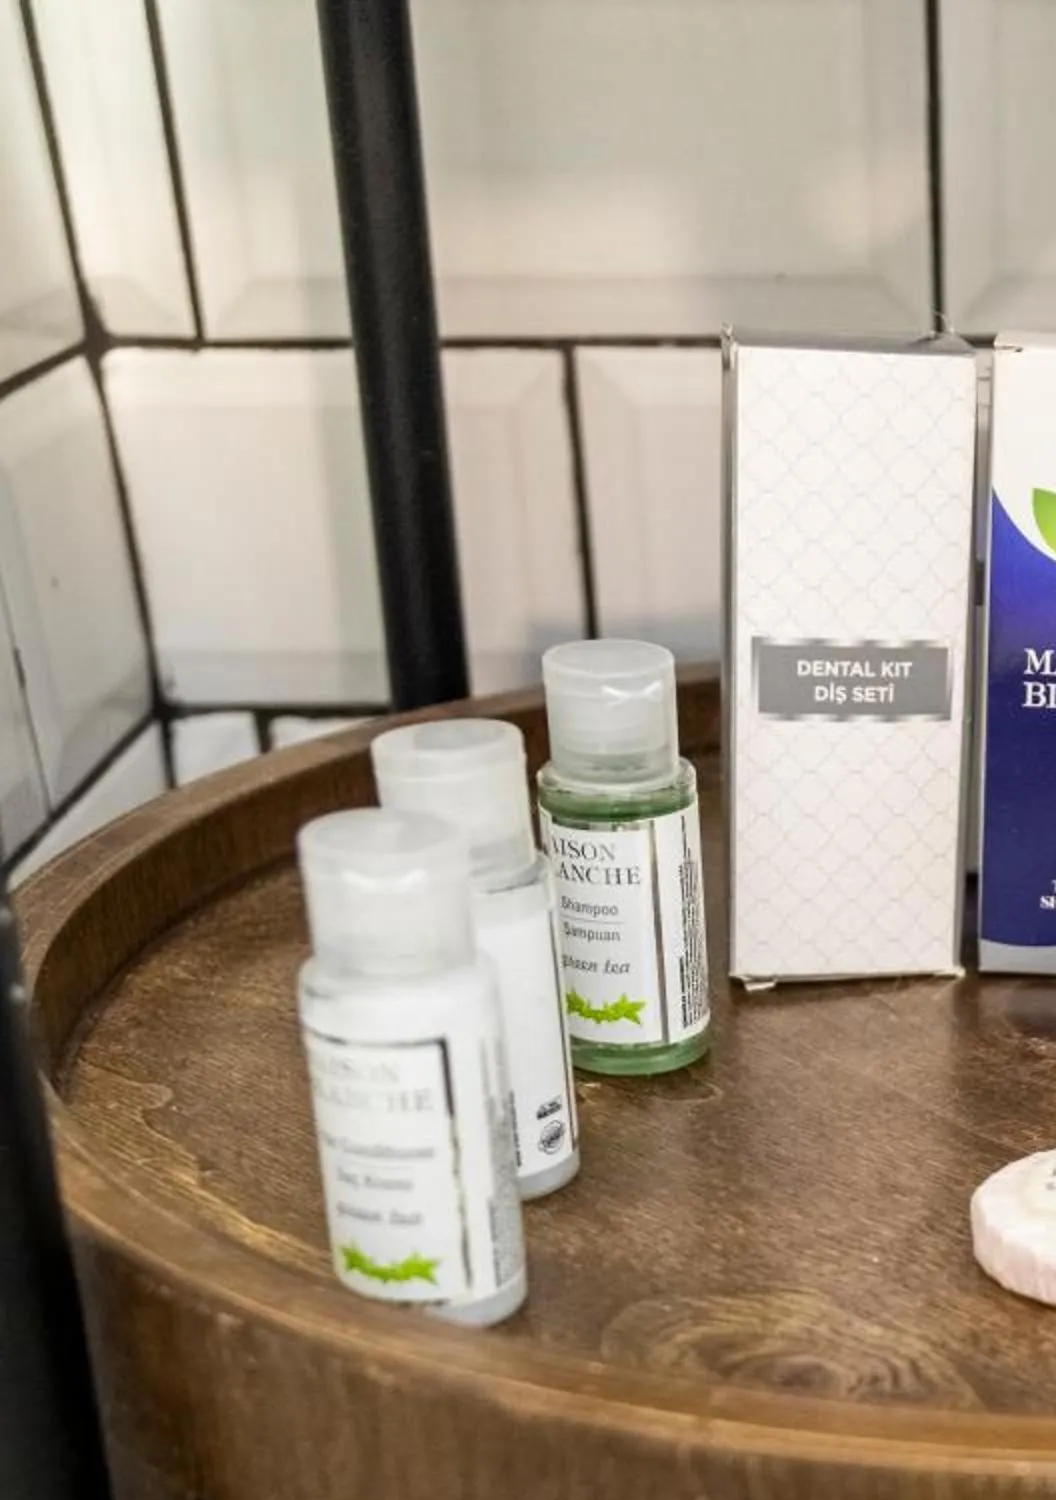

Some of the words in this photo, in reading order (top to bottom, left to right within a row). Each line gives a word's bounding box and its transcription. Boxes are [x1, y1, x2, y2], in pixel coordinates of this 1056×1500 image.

[797, 660, 876, 677] DENTAL
[881, 661, 913, 678] KIT
[550, 836, 616, 862] AISON
[555, 860, 642, 886] ANCHE
